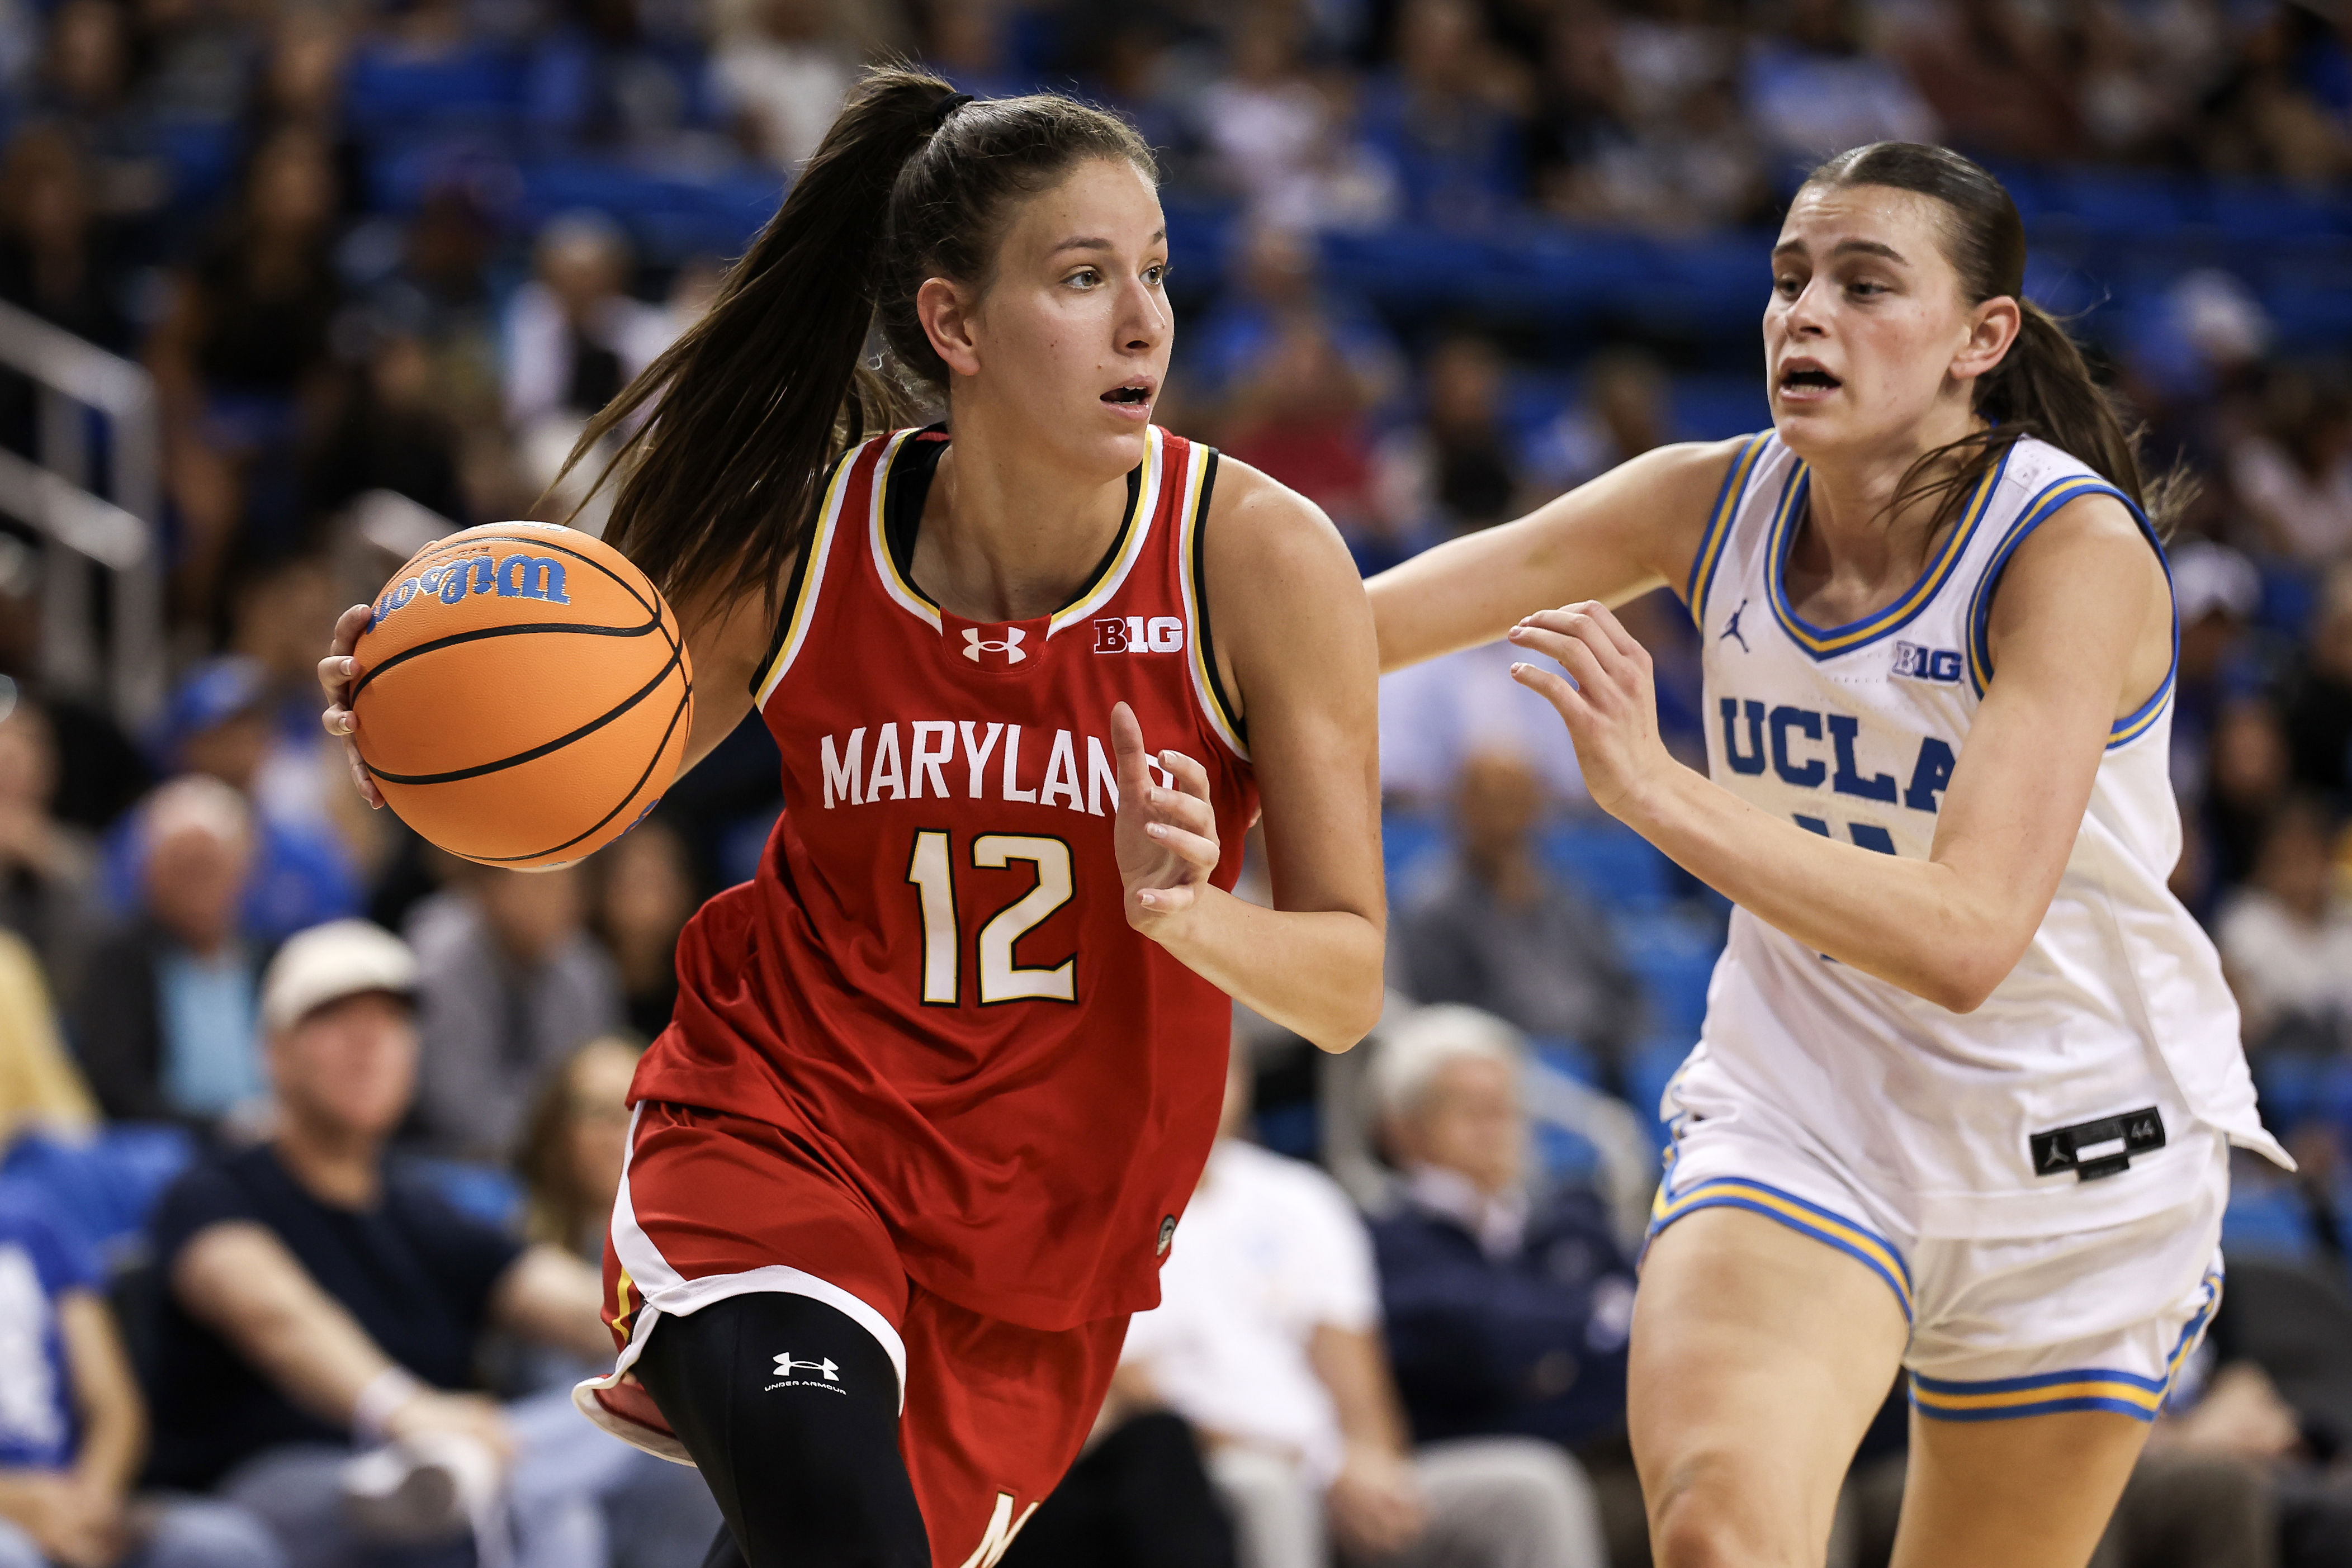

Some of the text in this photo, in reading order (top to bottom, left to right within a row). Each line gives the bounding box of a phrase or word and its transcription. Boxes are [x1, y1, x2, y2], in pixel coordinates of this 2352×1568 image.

[366, 553, 571, 634] Wilson
[1720, 697, 1957, 814] UCLA
[904, 827, 1078, 1007] 12
[2131, 1119, 2156, 1140] 44
[764, 1381, 846, 1395] UNDER ARMOUR
